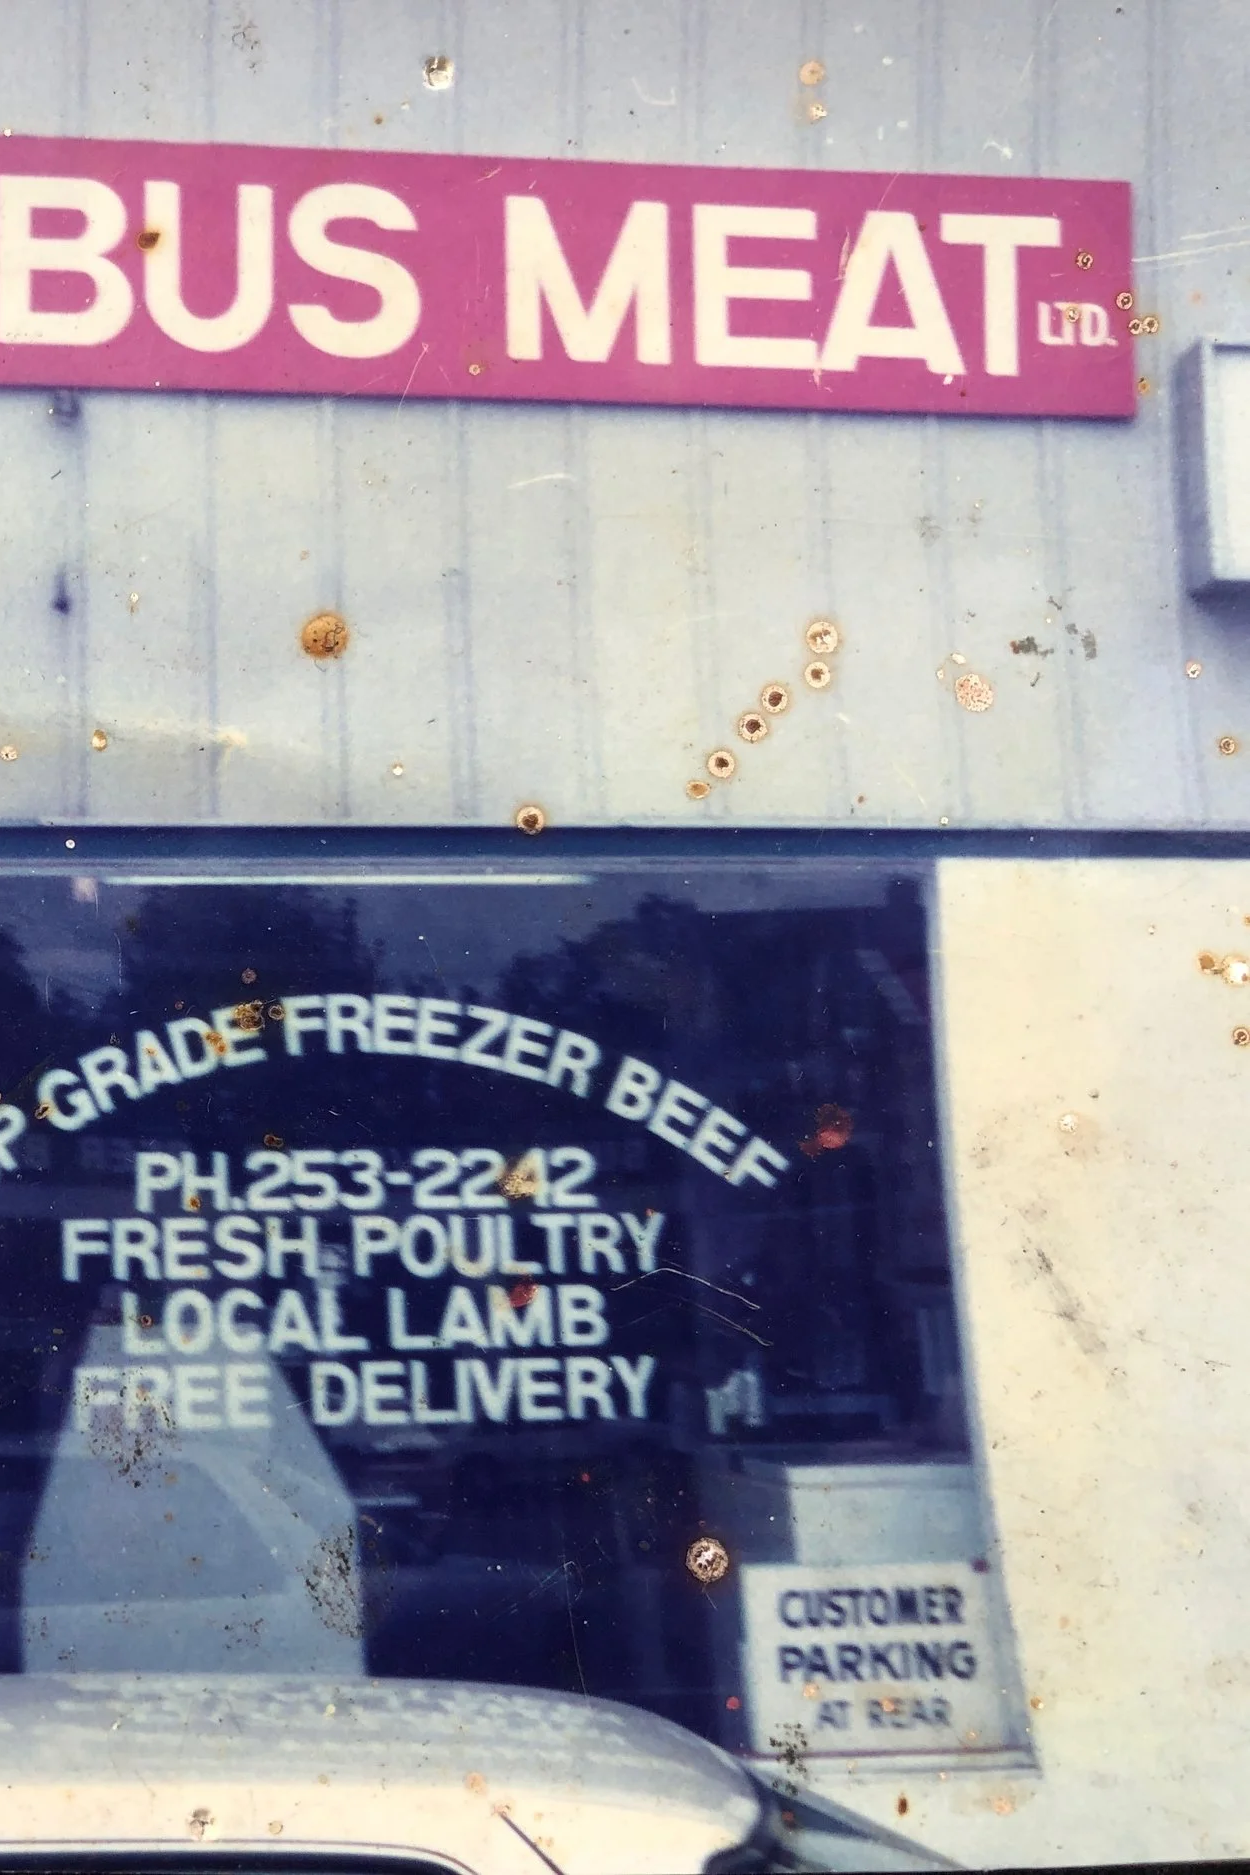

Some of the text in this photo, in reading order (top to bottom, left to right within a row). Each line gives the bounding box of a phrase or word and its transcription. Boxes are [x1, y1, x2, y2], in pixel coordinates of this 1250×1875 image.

[504, 195, 1062, 377] MEAT
[1037, 301, 1118, 347] LTD.
[37, 1004, 267, 1131] GRADE
[282, 993, 601, 1097] FREEZER
[604, 1056, 790, 1189] BEEF
[135, 1147, 598, 1212] PH.253-2242
[62, 1212, 664, 1282] FRESH POULTRY
[122, 1285, 610, 1355] LOCAL LAMB
[73, 1355, 656, 1432] FREE DELIVERY
[778, 1586, 966, 1629] CUSTOMER
[777, 1641, 978, 1684] PARKING
[817, 1697, 950, 1731] AT REAR
